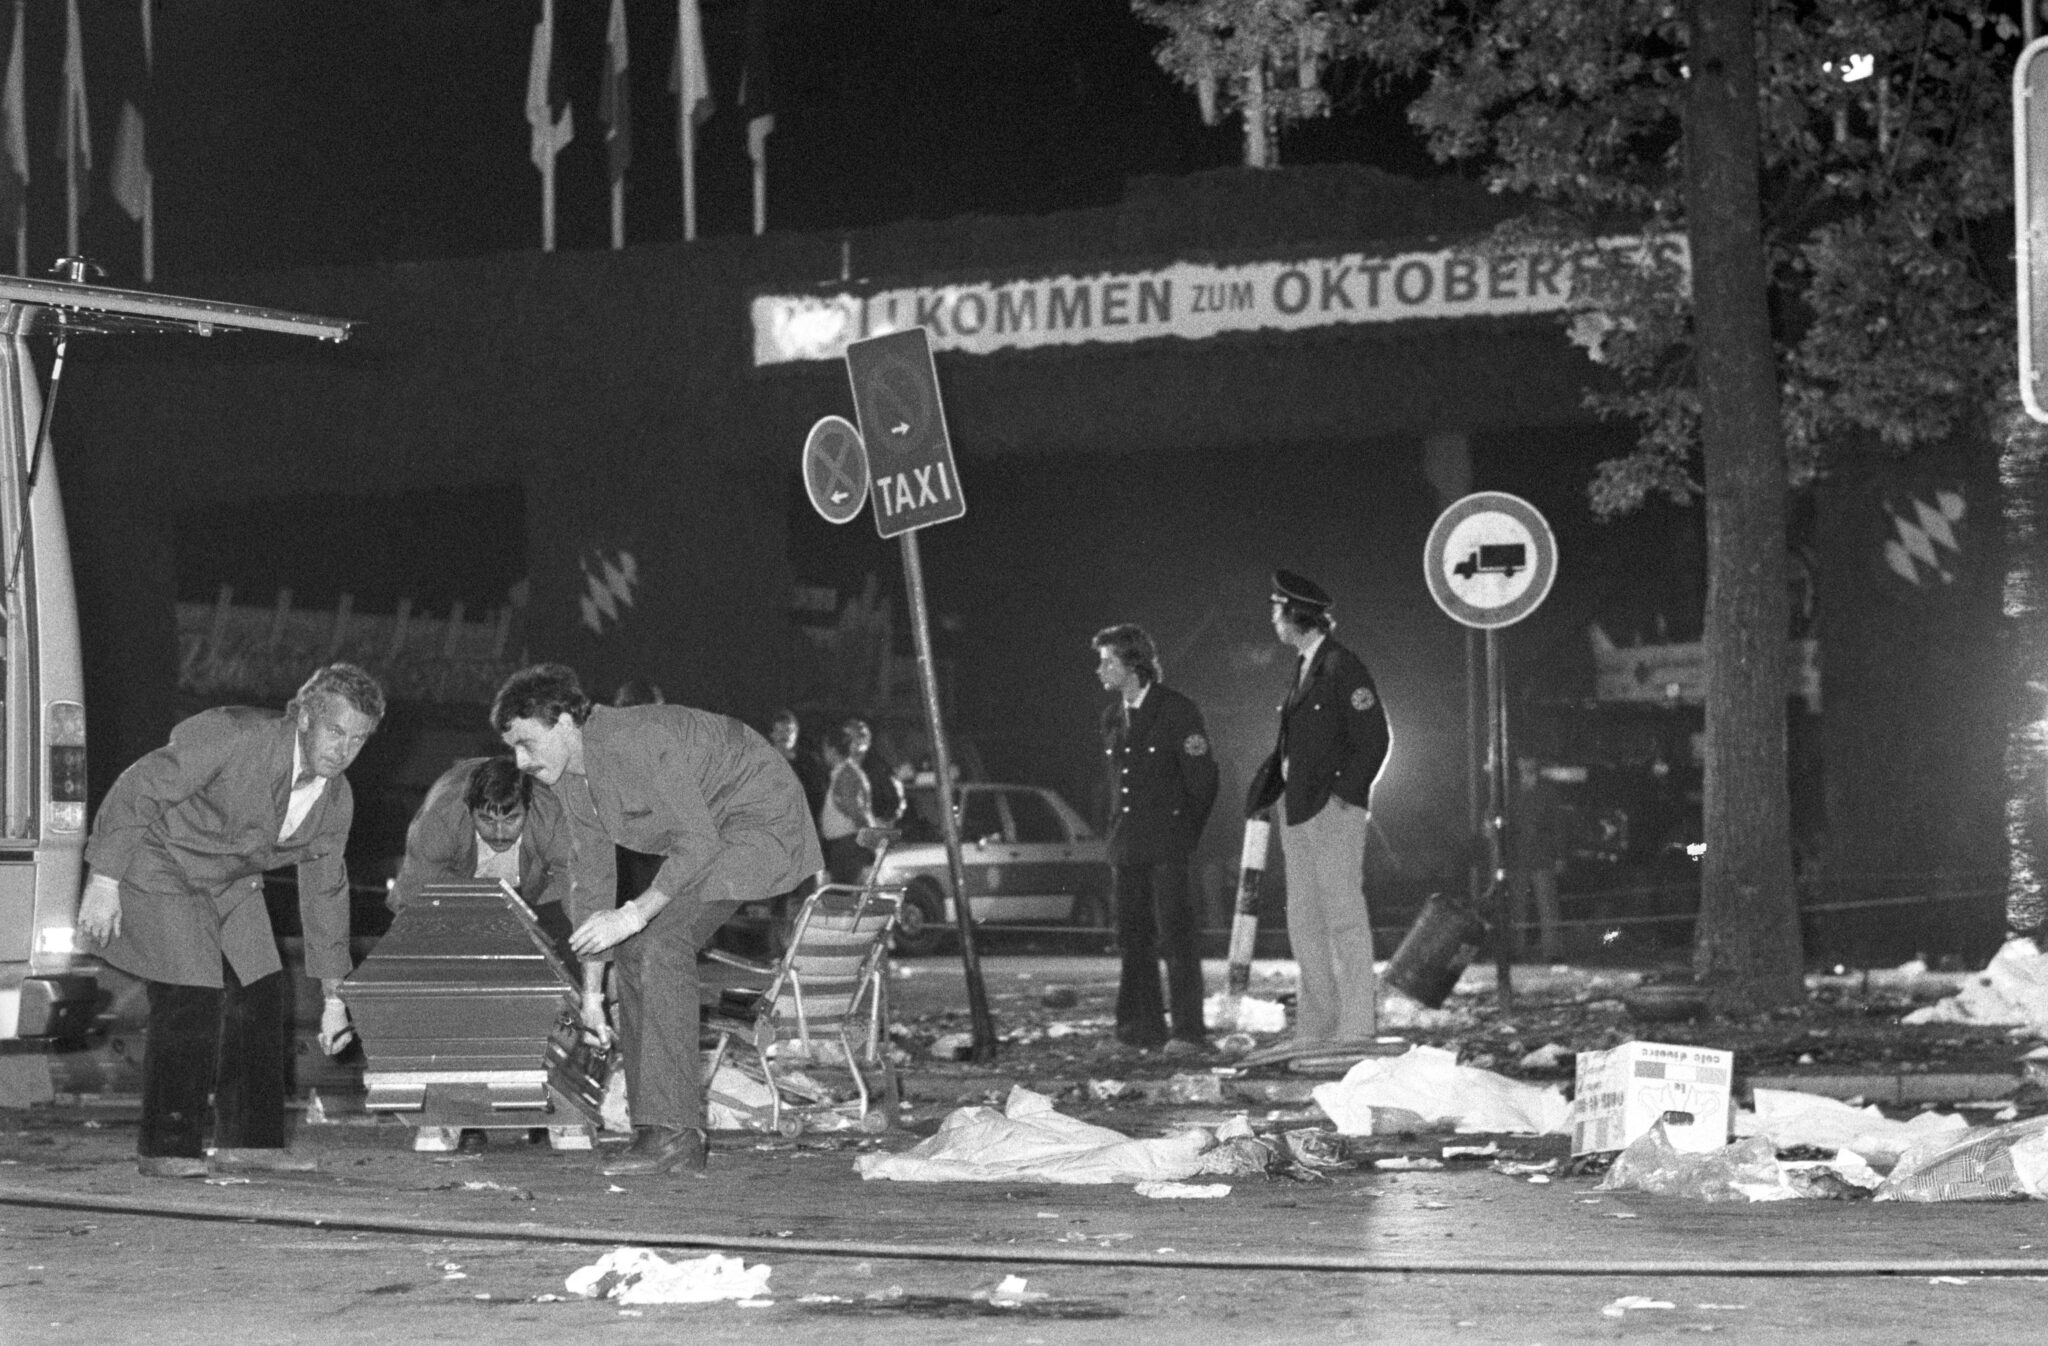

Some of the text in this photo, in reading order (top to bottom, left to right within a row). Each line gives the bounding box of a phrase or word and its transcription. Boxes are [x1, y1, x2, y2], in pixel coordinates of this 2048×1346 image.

[1192, 282, 1255, 313] ZUM
[1273, 241, 1686, 315] OKTOBERFES
[876, 461, 951, 517] TAXI
